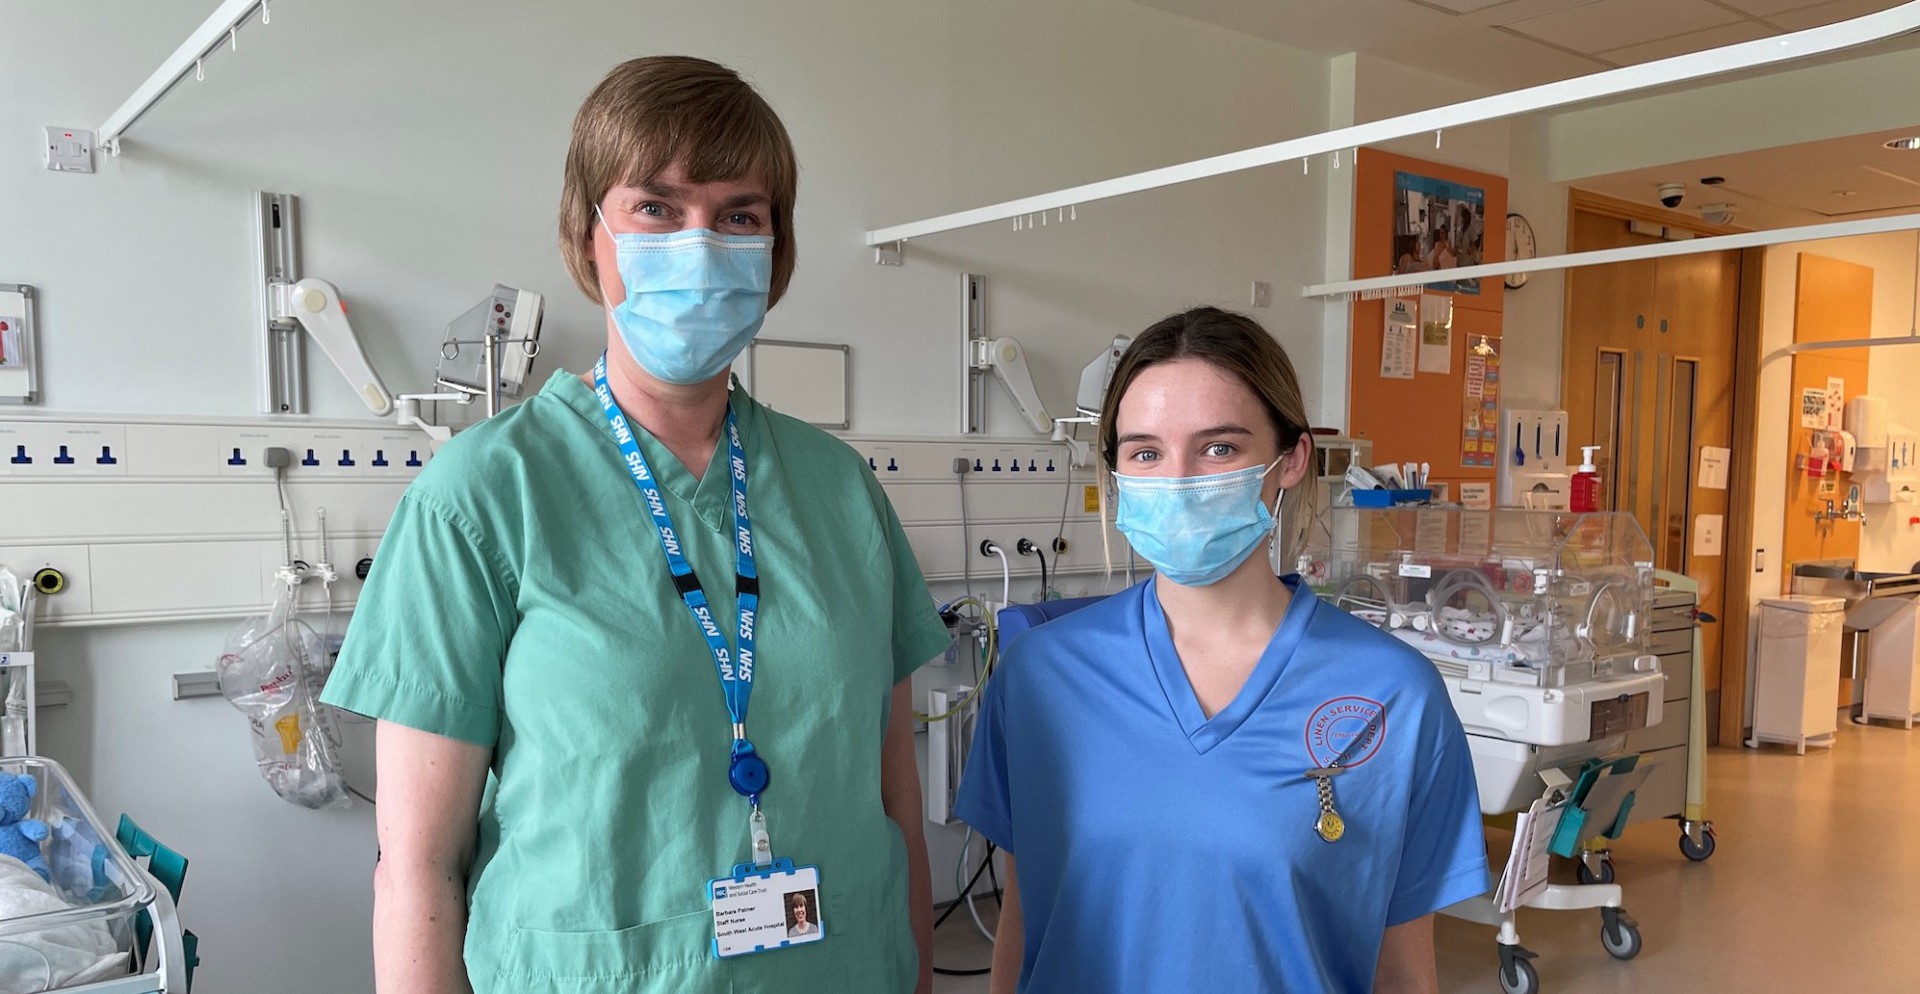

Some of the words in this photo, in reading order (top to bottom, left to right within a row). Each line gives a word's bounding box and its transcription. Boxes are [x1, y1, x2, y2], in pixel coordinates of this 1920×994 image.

[595, 384, 613, 410] NHS
[610, 415, 632, 445] NHS
[625, 451, 650, 481] NHS
[732, 455, 746, 484] NHS
[644, 488, 666, 517] NHS
[736, 489, 749, 520] NHS
[660, 526, 681, 556] NHS
[738, 525, 752, 557] NHS
[695, 606, 720, 637] NHS
[739, 608, 754, 641] NHS
[715, 648, 736, 681] NHS
[739, 647, 753, 683] NHS
[260, 670, 293, 692] Ambu
[1314, 715, 1329, 746] LINEN
[763, 921, 785, 930] Hospital
